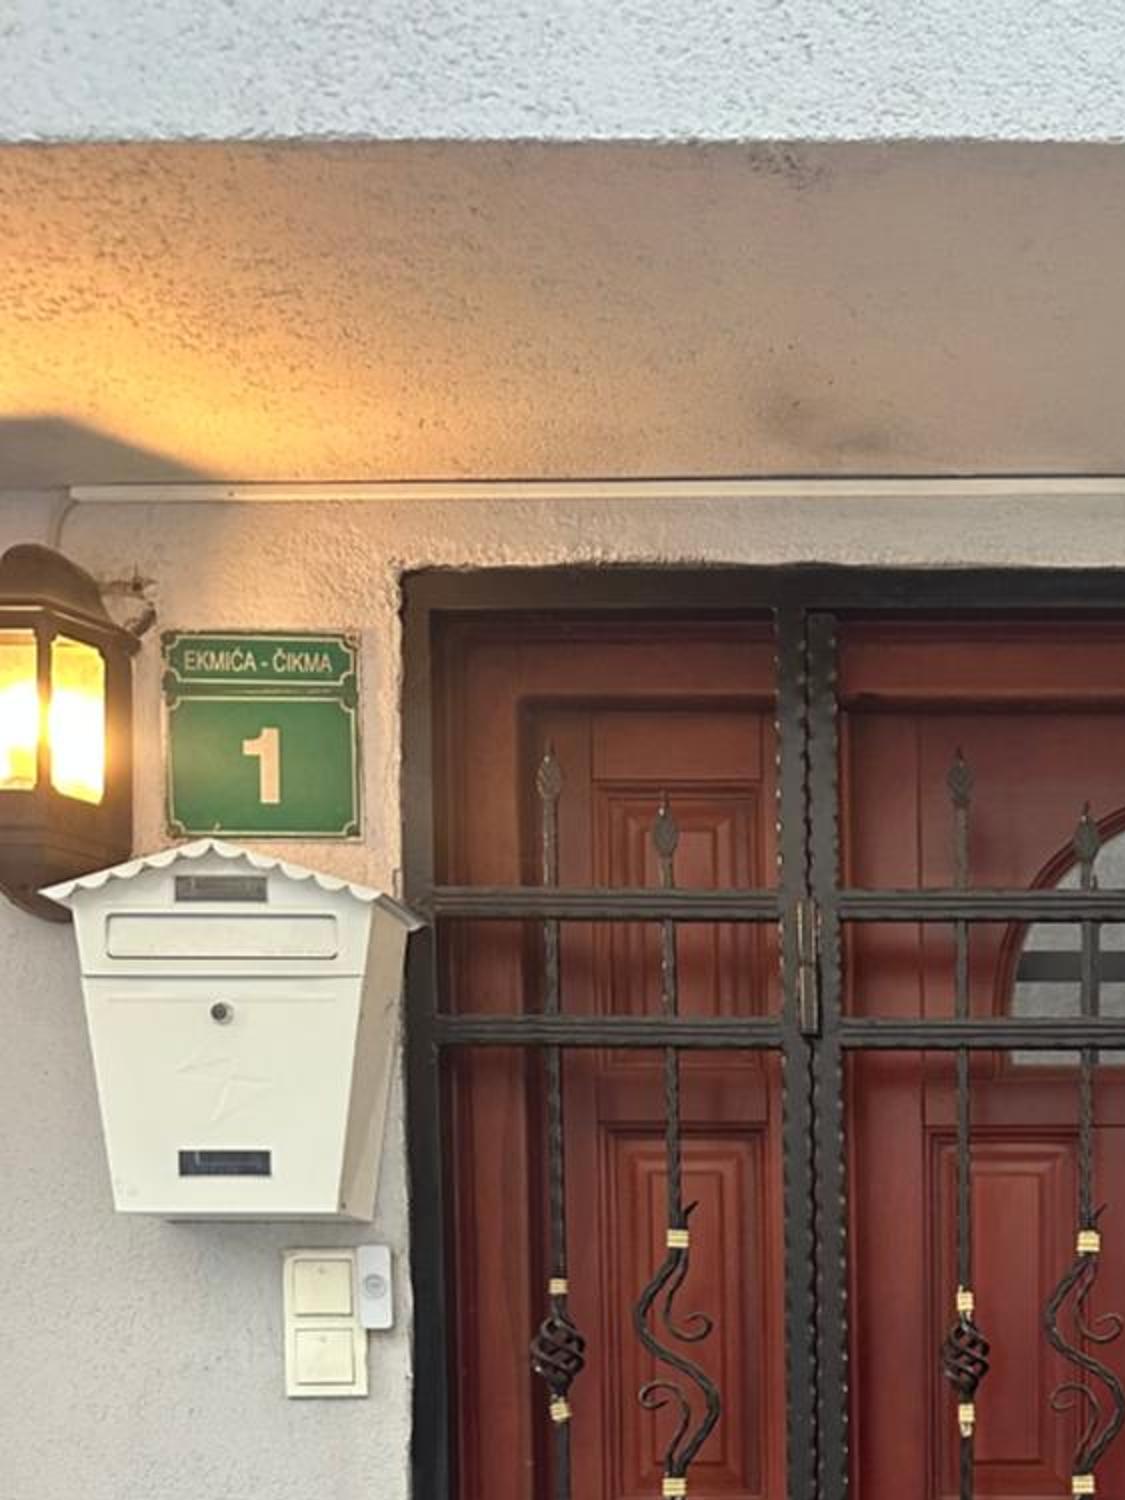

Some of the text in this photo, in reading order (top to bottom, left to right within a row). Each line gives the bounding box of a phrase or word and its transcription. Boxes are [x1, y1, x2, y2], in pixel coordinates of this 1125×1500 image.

[184, 647, 256, 672] EKMIĆA
[272, 648, 333, 673] ČIKMA
[242, 727, 281, 804] 1
